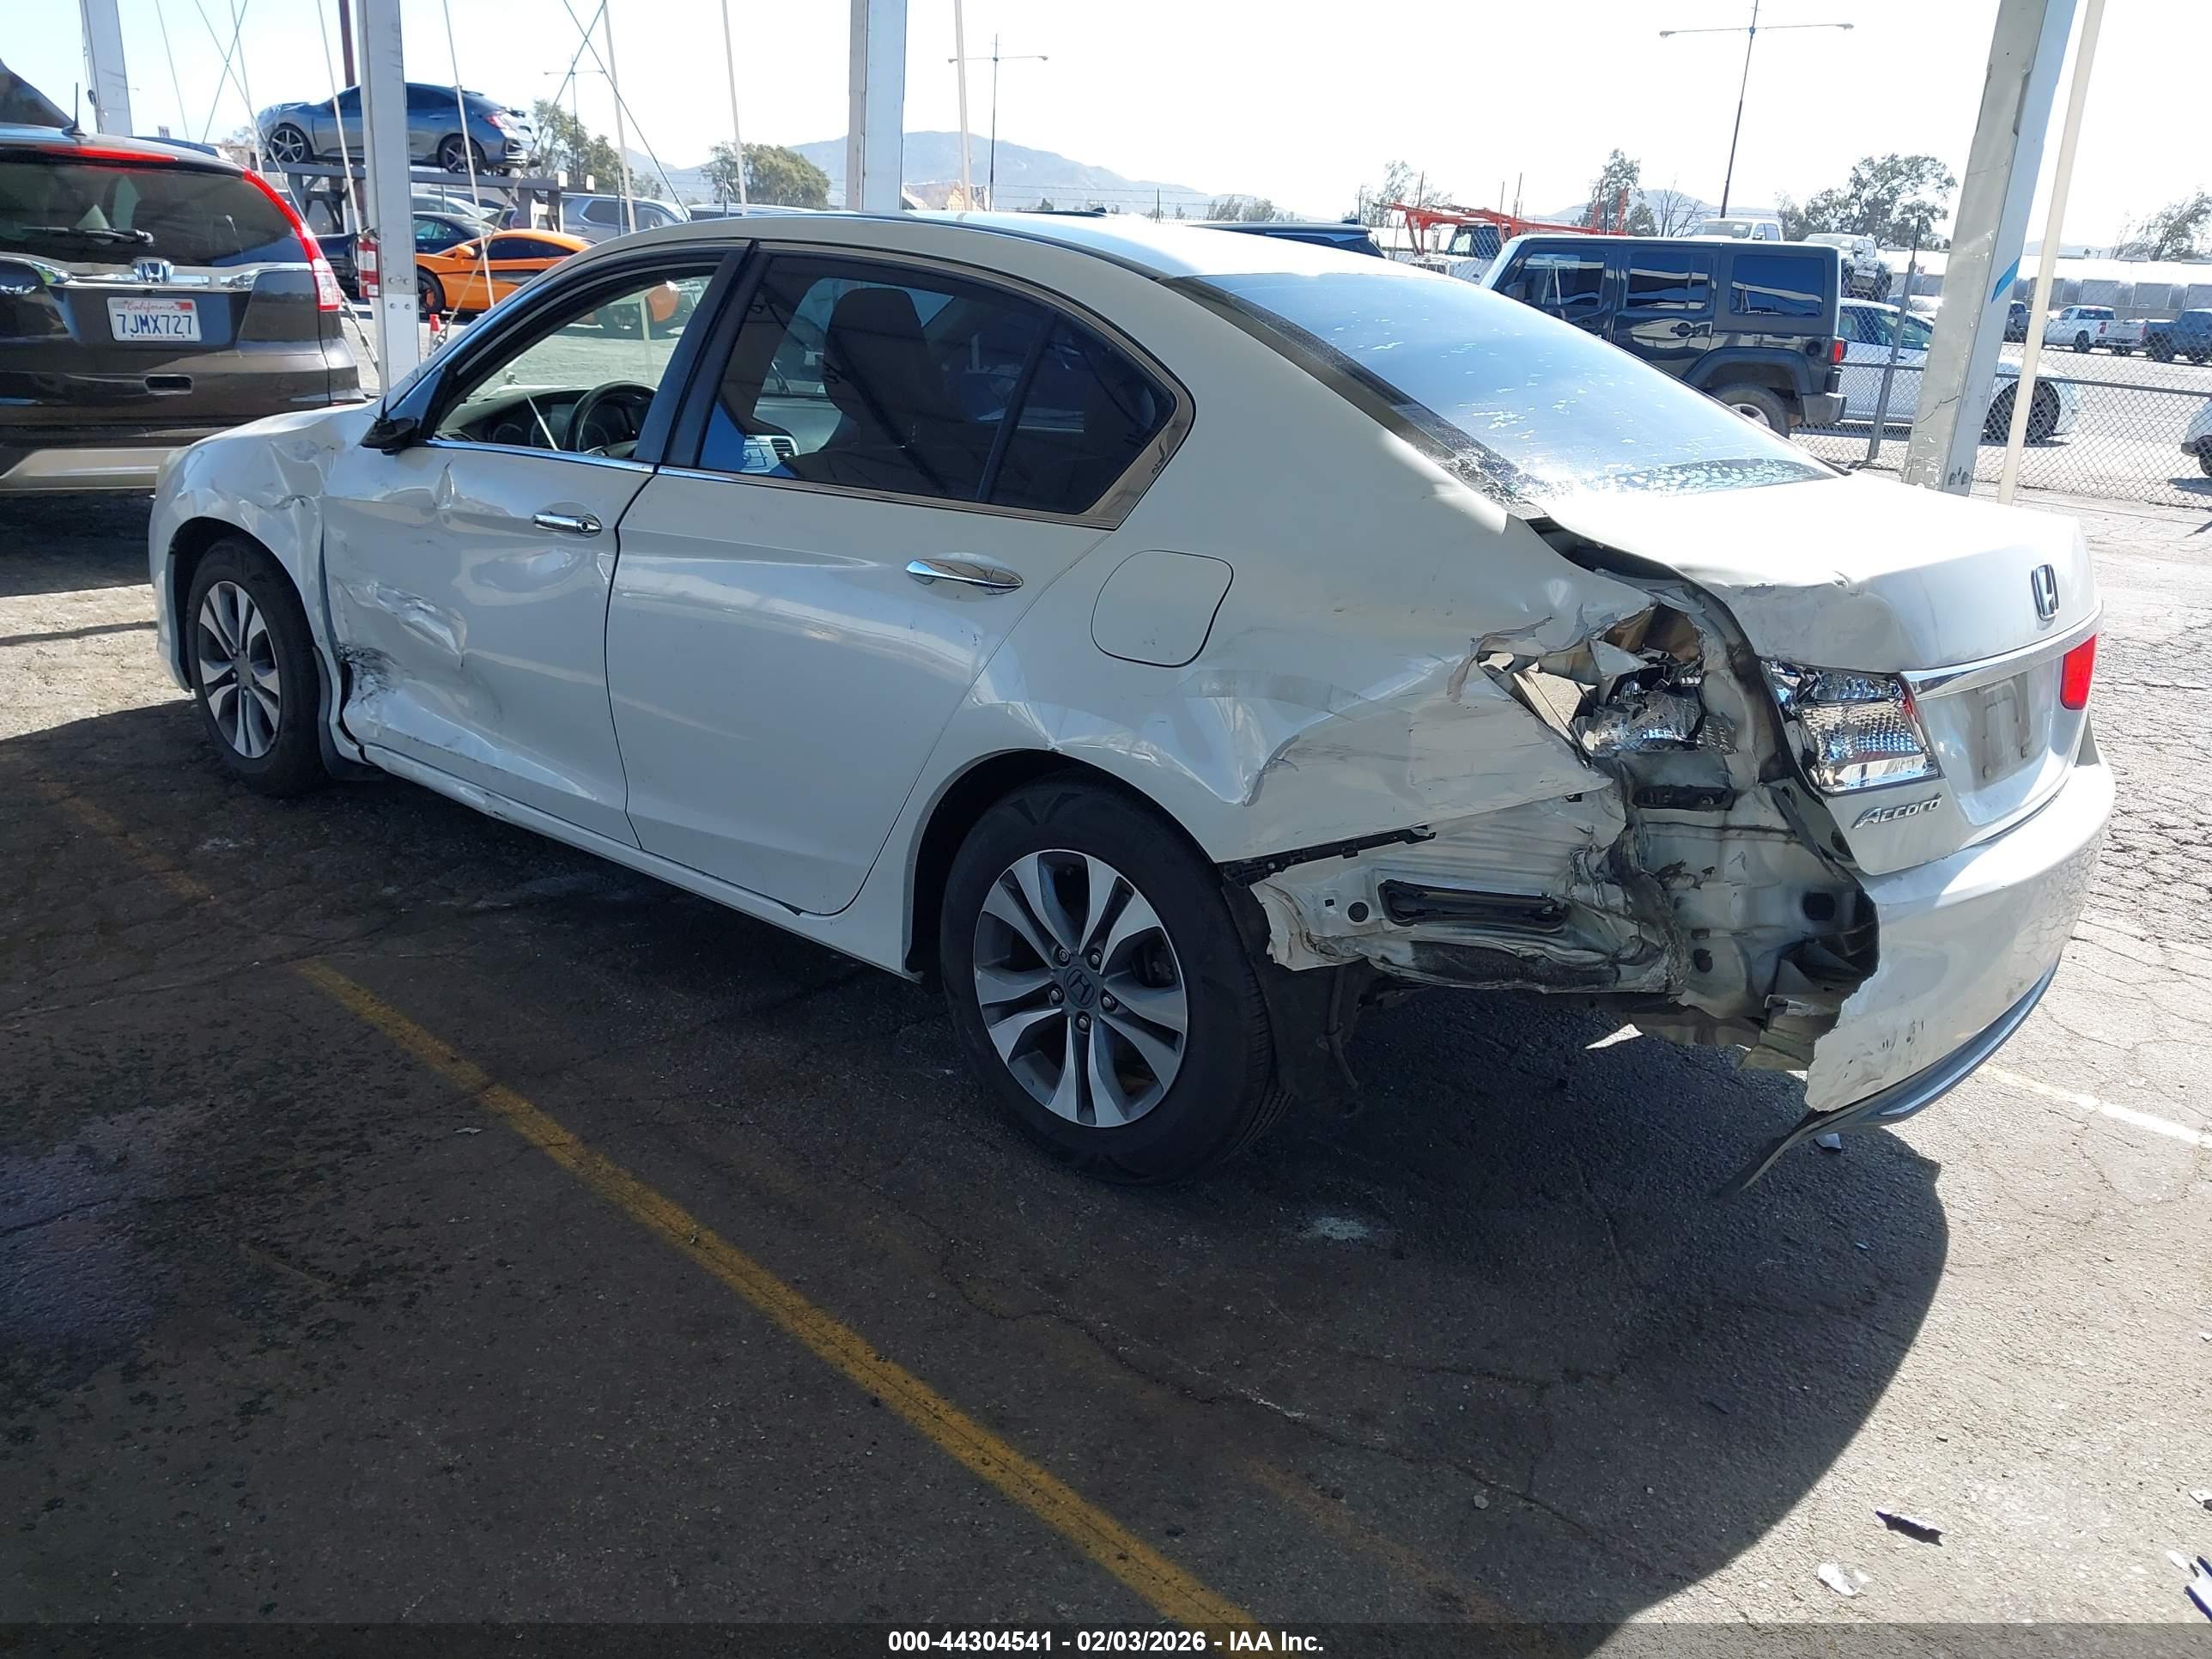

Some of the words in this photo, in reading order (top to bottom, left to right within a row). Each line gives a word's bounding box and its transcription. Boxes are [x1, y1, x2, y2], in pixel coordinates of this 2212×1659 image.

[125, 301, 178, 313] California
[116, 313, 192, 335] 7JMX727
[1851, 792, 1943, 830] Accord
